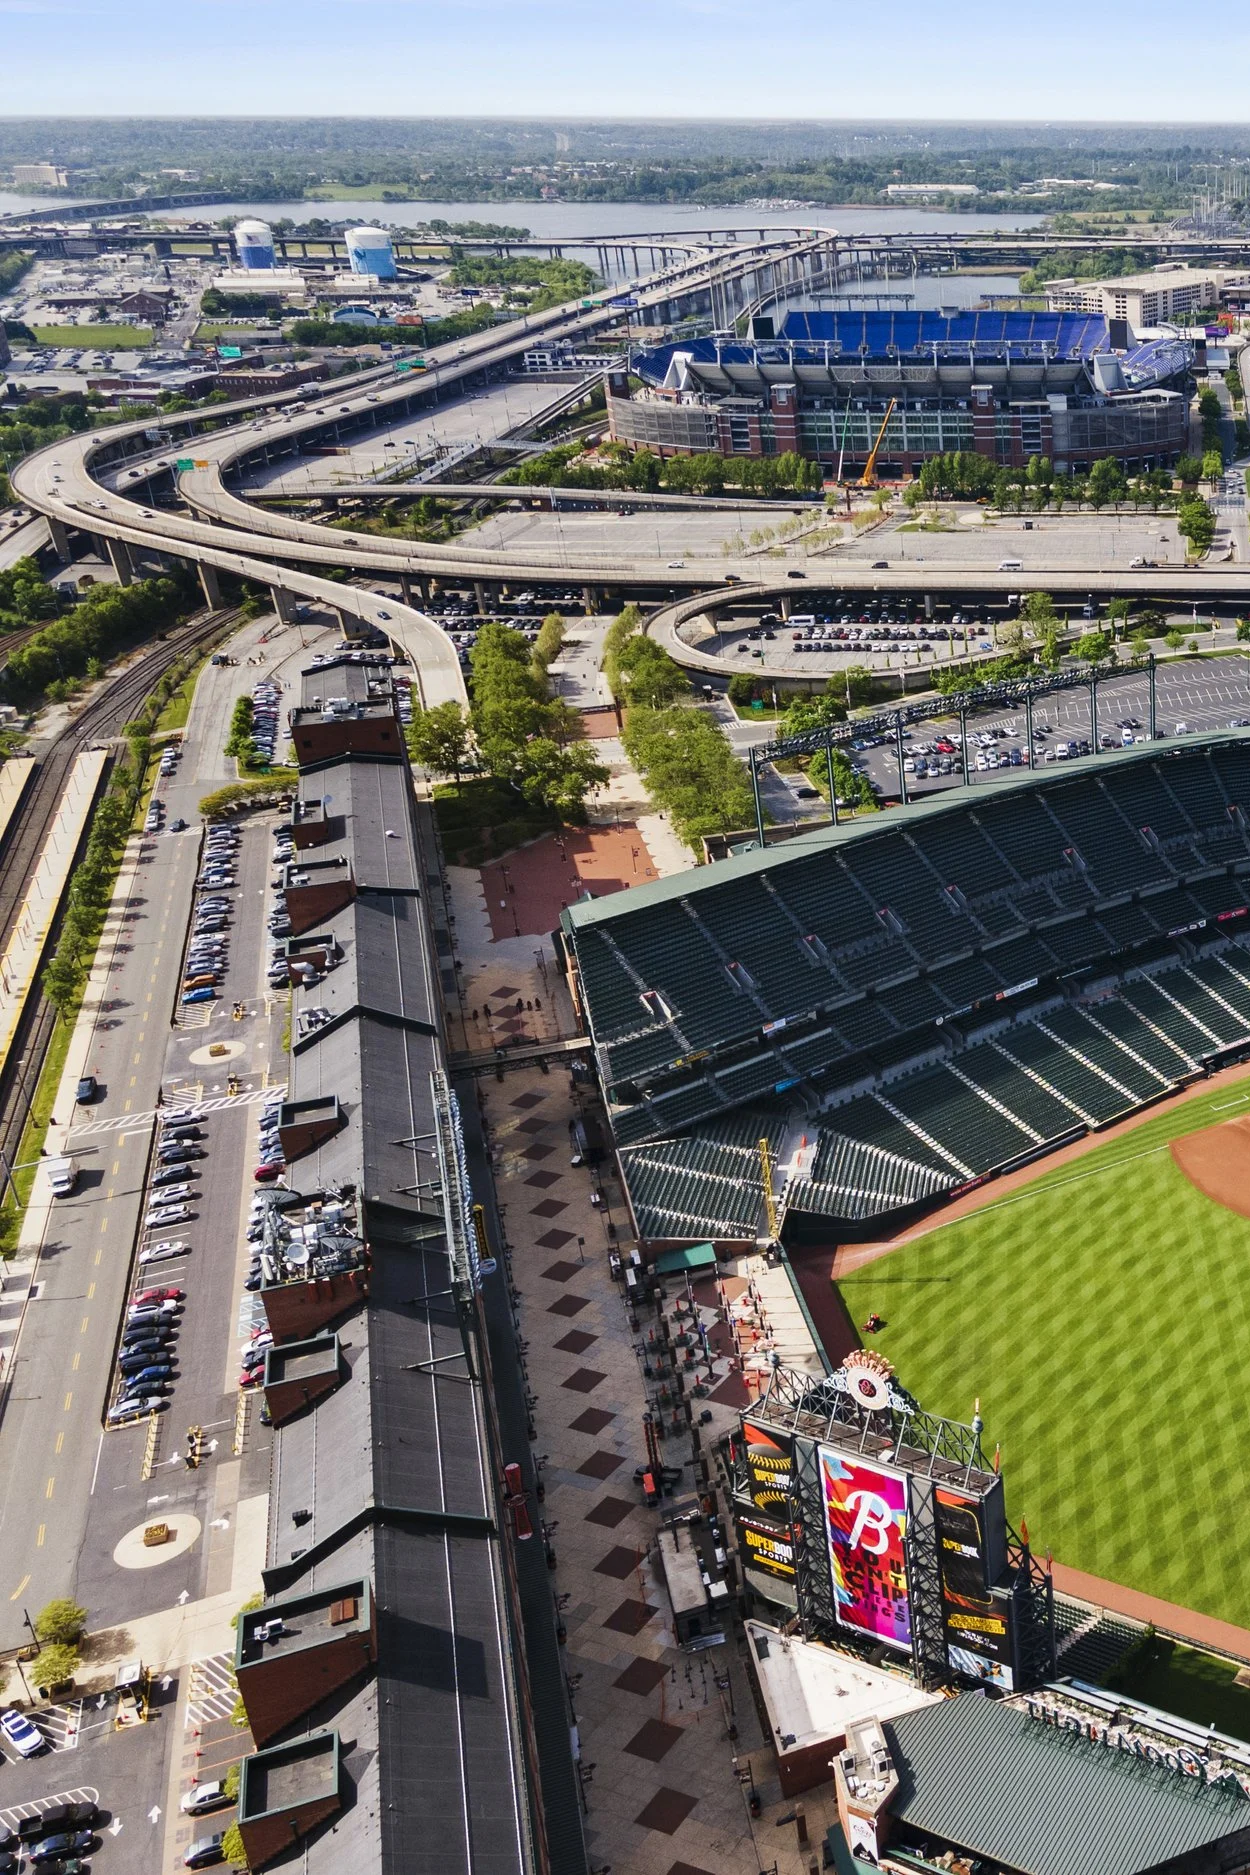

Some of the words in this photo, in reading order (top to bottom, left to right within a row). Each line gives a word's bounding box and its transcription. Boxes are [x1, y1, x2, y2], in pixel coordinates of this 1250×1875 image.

[764, 1481, 788, 1490] SPORTS
[845, 1490, 892, 1555] B
[758, 1548, 788, 1564] SPORTS
[843, 1542, 903, 1575] YOU
[942, 1537, 980, 1559] SUPERBOOK
[843, 1557, 903, 1587] CAN'T
[845, 1570, 904, 1604] CLIP
[849, 1594, 906, 1623] WINGS
